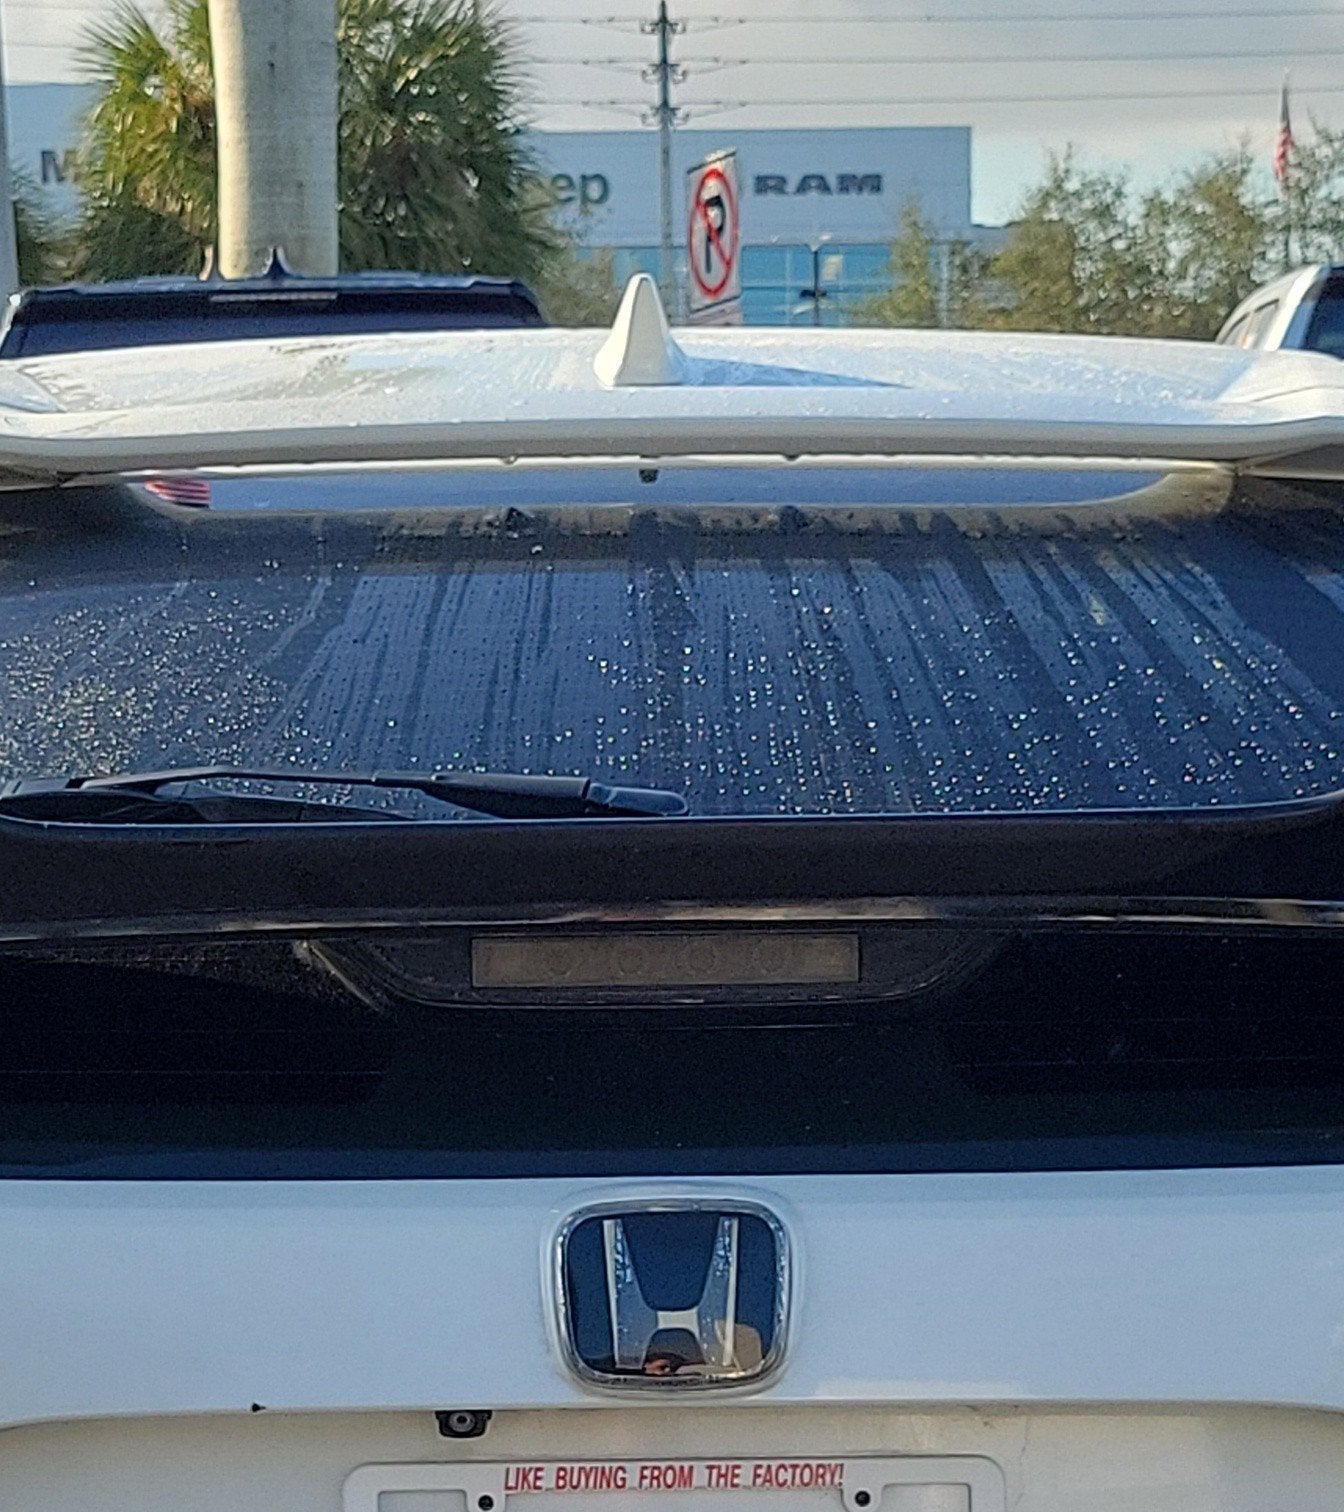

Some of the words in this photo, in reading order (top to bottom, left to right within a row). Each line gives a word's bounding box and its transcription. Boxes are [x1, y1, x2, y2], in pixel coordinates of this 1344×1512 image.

[755, 173, 883, 196] RAM
[504, 1466, 545, 1491] LIKE
[555, 1465, 628, 1491] BUYING
[637, 1464, 695, 1490] FROM
[705, 1464, 741, 1489] THE
[751, 1462, 845, 1488] FACTORY!
